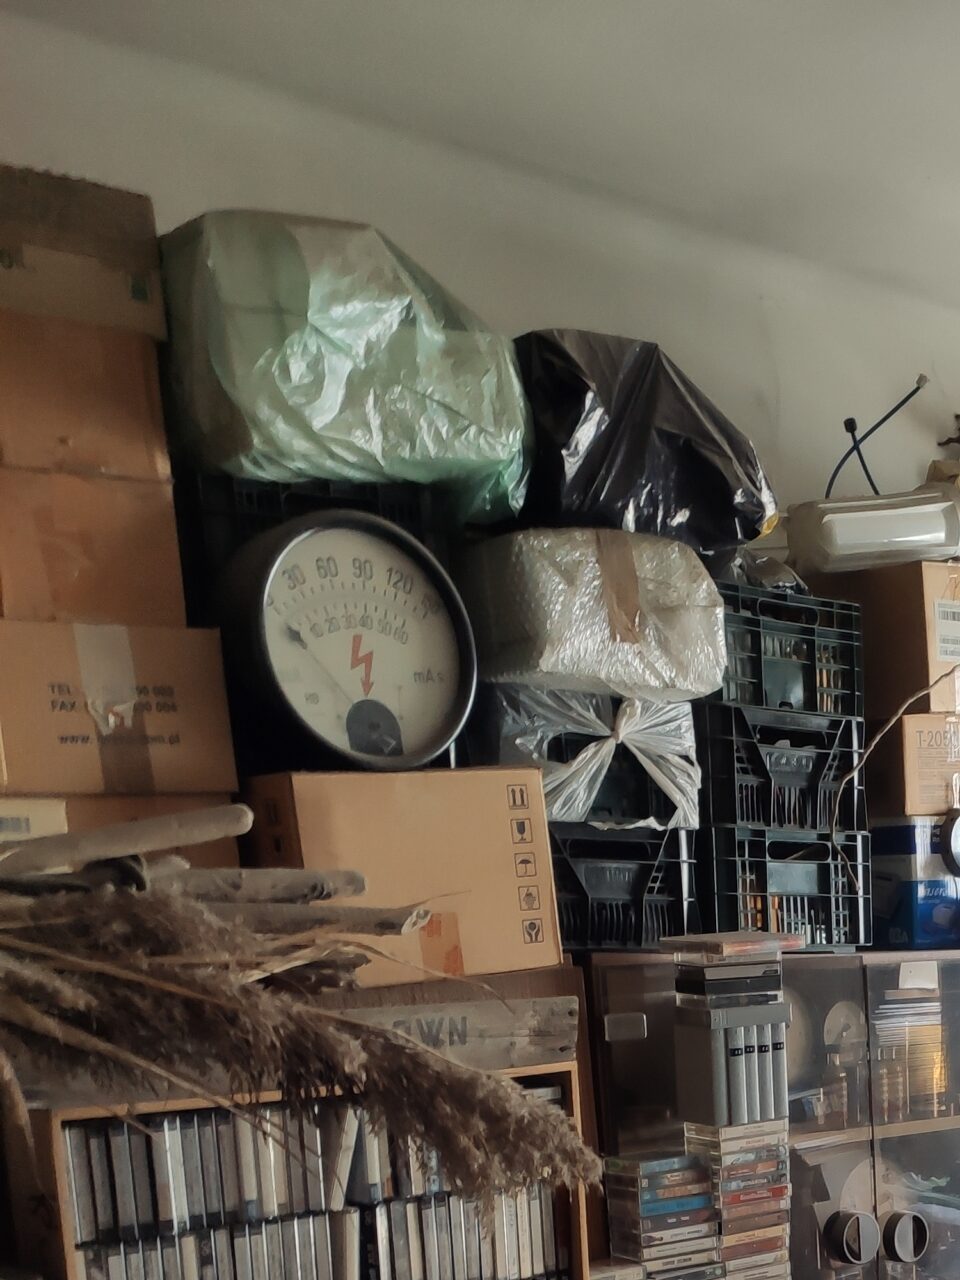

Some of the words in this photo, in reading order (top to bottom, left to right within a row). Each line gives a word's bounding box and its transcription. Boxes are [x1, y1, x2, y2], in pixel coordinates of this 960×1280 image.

[282, 564, 306, 590] 30
[316, 557, 338, 579] 60
[352, 558, 373, 581] 90
[386, 567, 414, 595] 120
